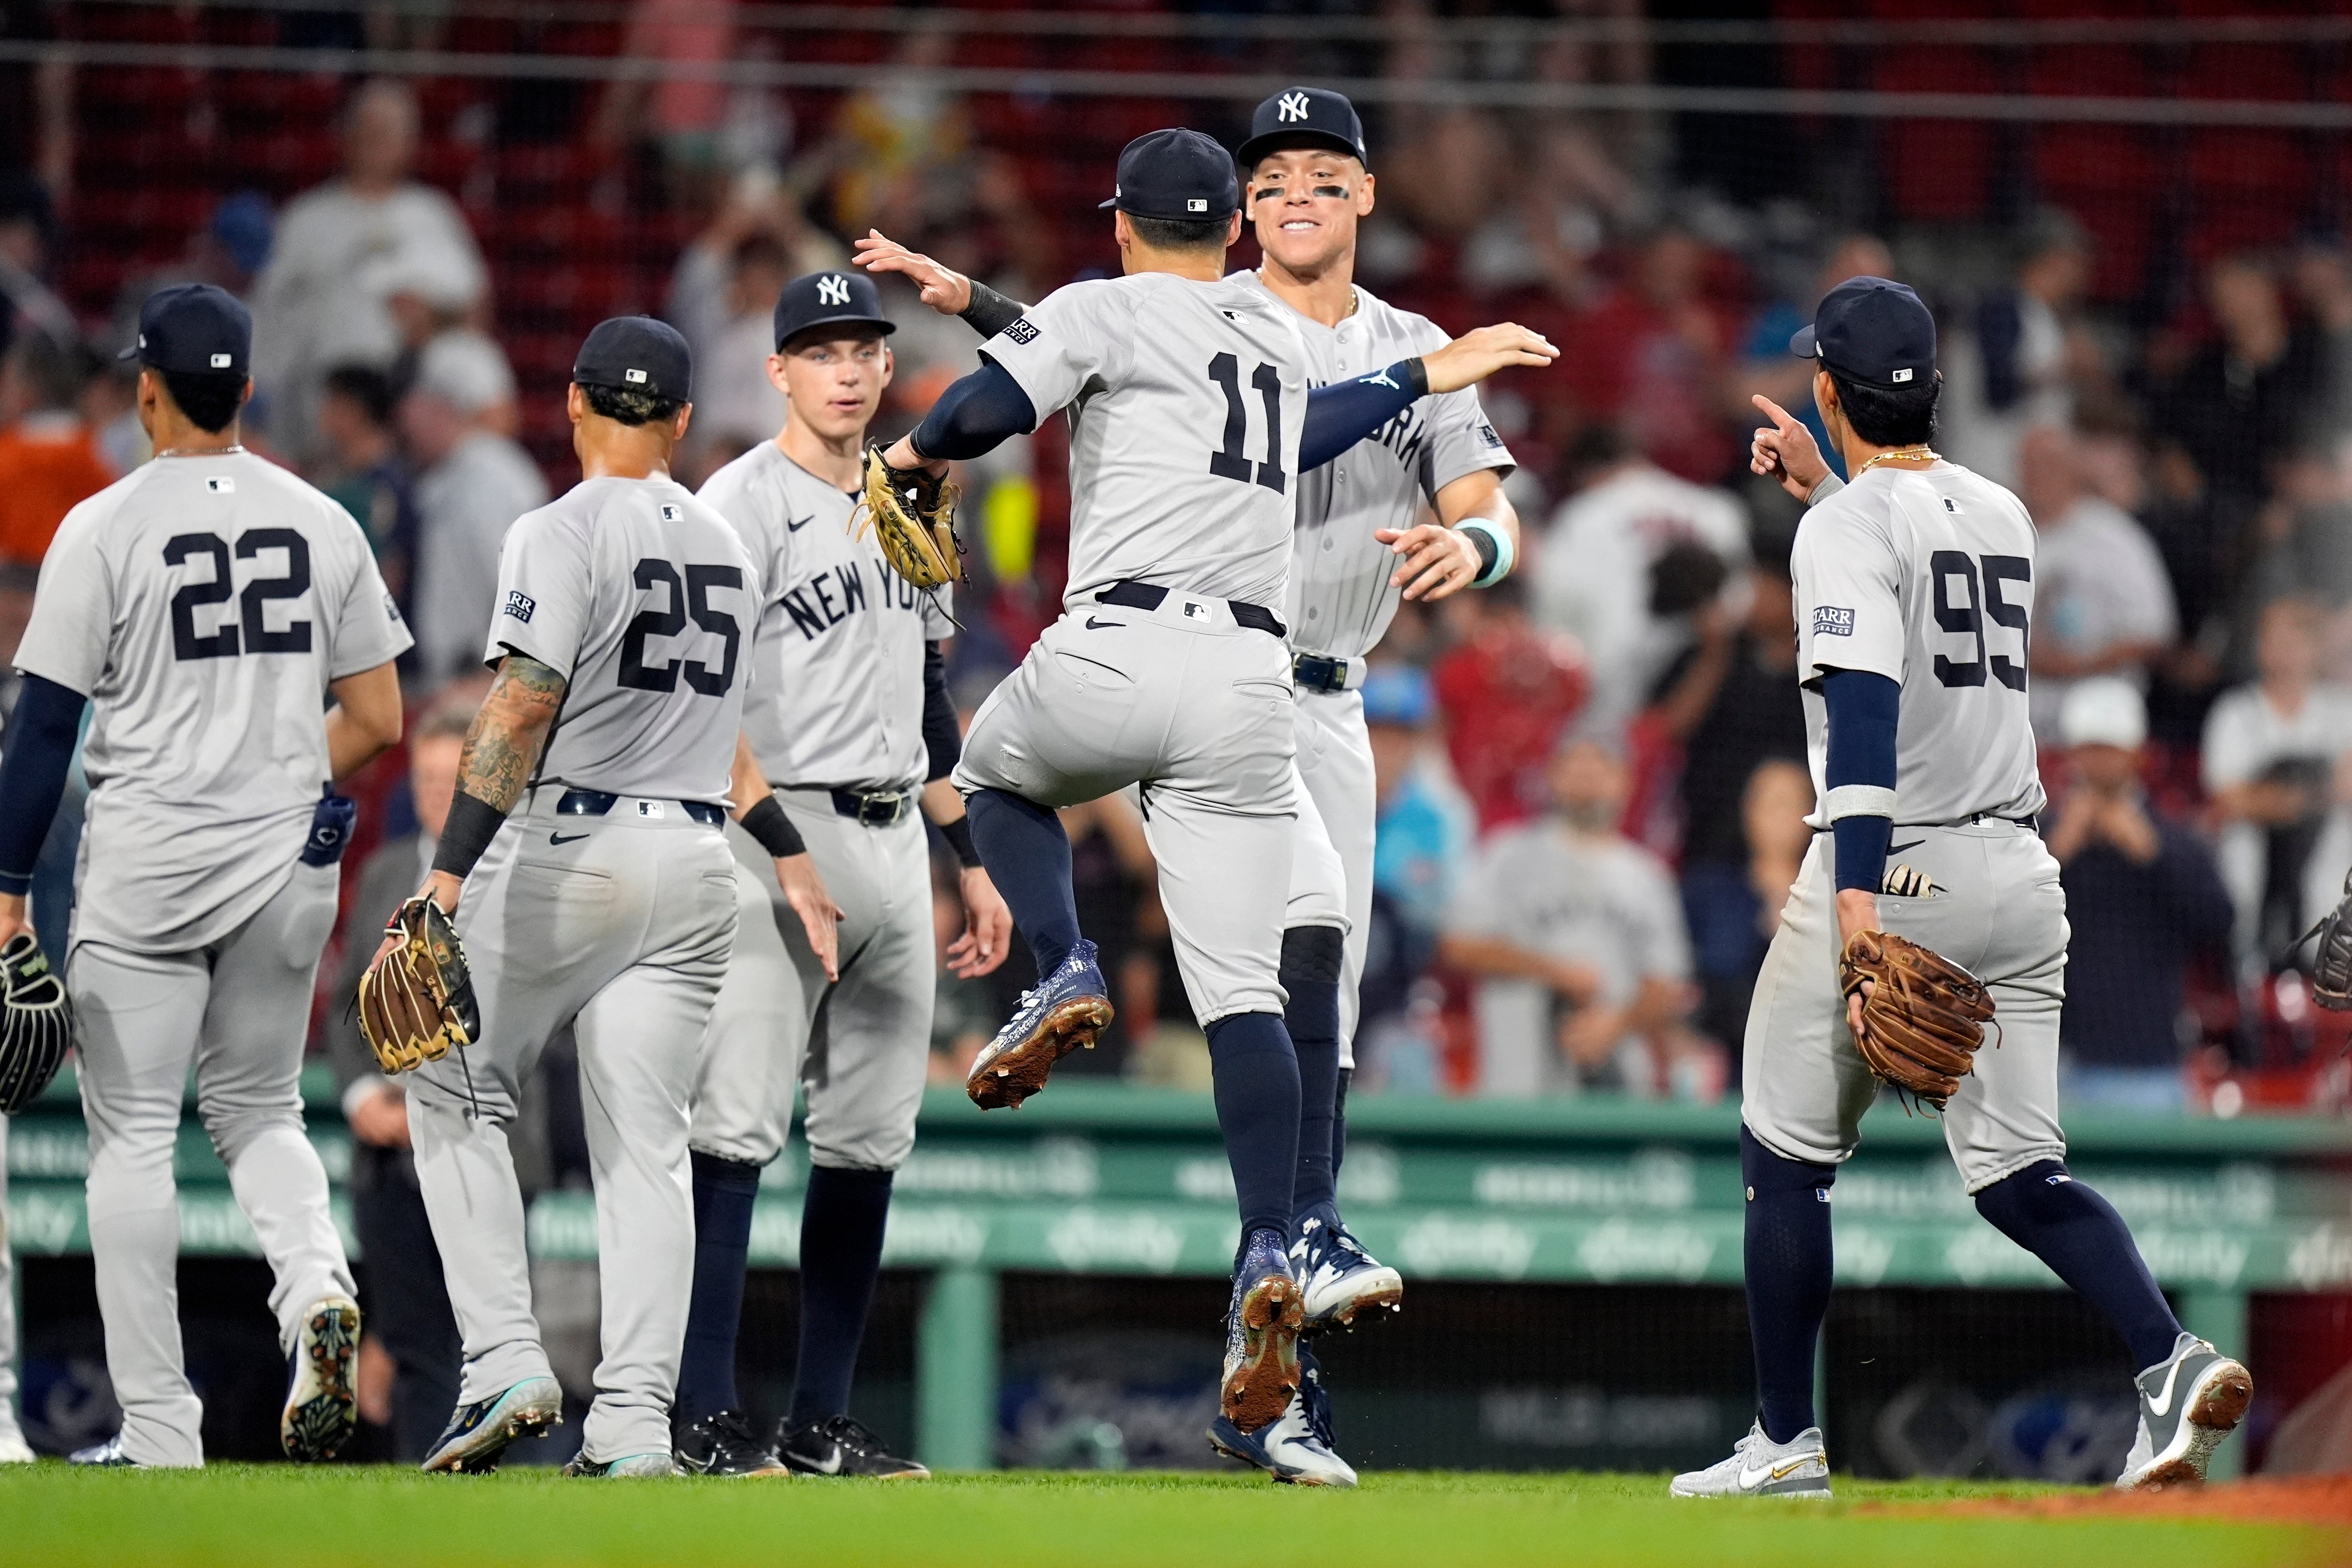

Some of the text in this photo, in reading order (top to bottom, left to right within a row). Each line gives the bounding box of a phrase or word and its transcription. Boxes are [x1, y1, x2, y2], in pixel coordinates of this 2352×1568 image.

[1278, 92, 1310, 122] NY
[817, 274, 851, 306] NY
[1208, 351, 1285, 496] 11
[162, 527, 312, 661] 22
[617, 559, 743, 697] 25
[780, 561, 866, 641] NEW
[1930, 550, 2030, 692] 95
